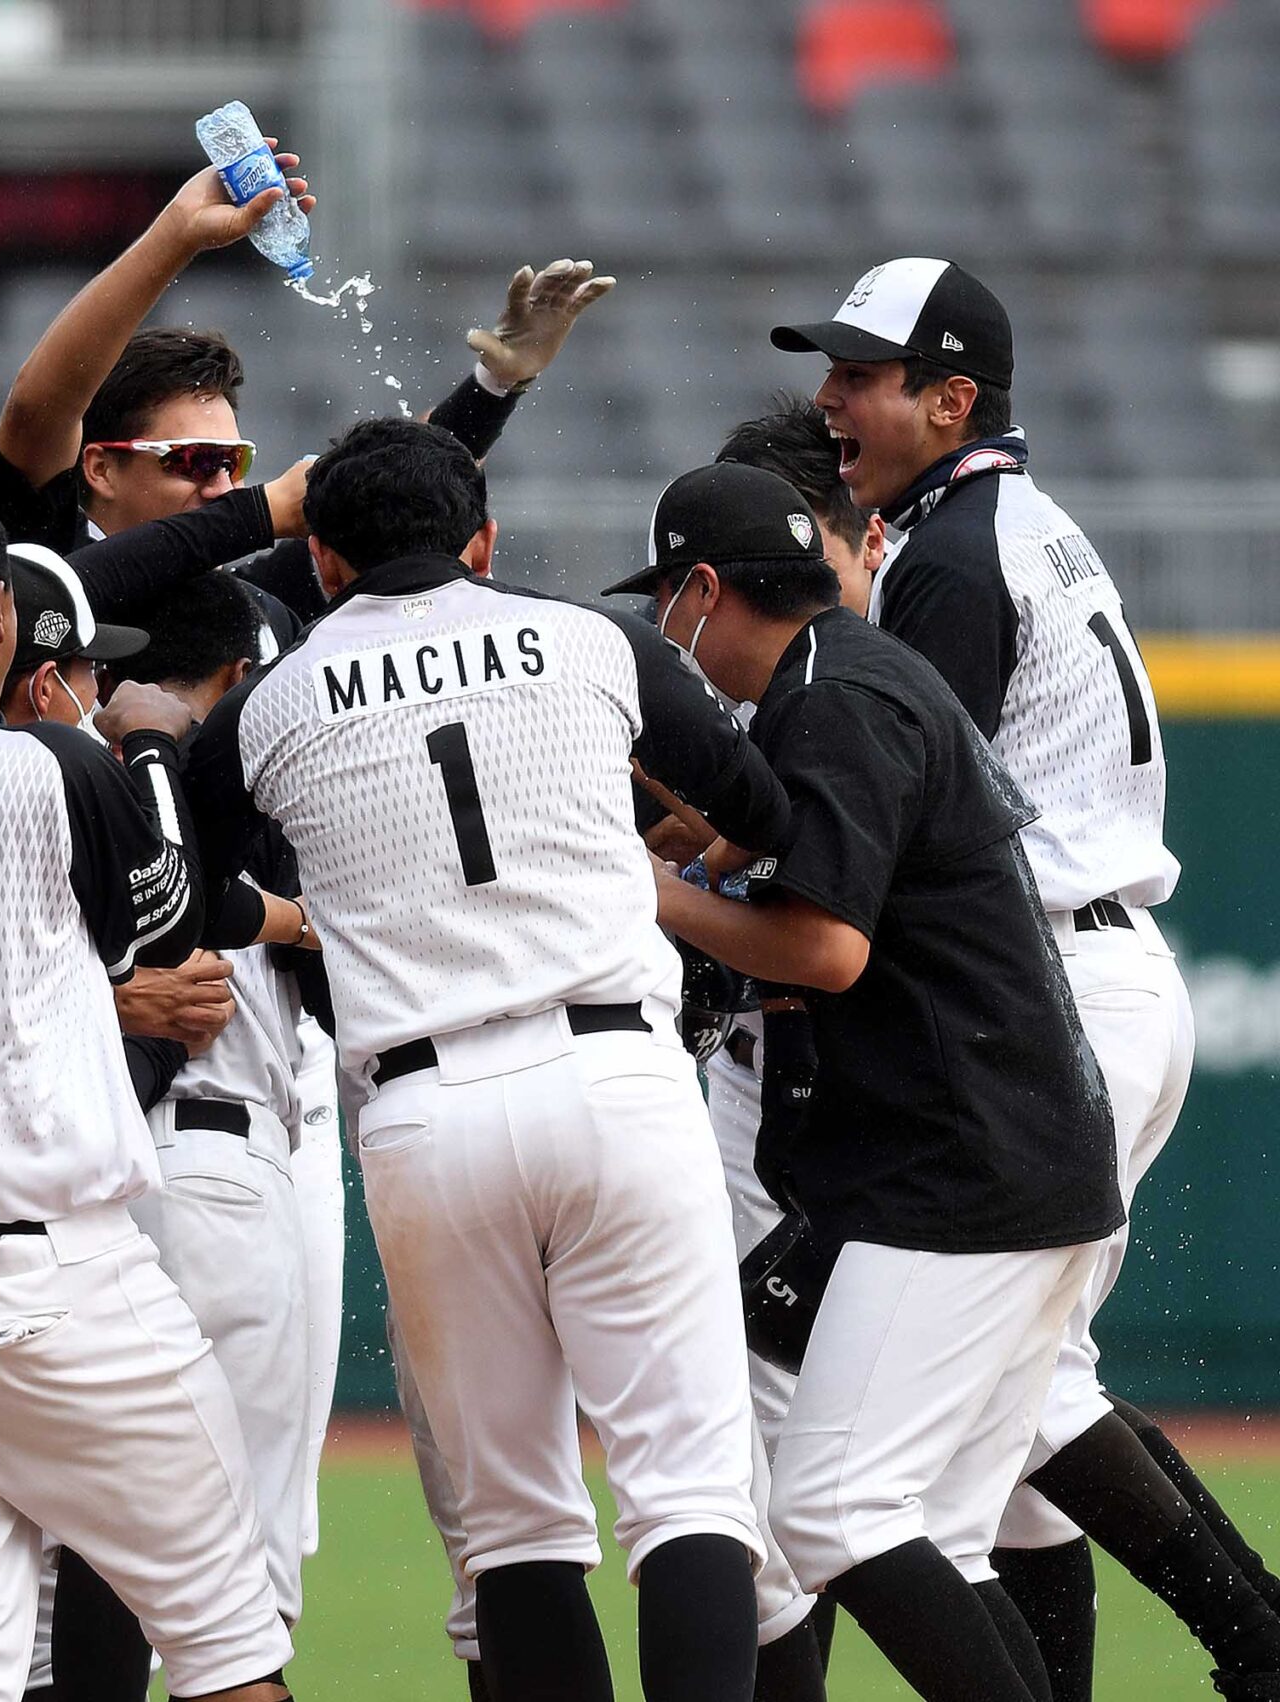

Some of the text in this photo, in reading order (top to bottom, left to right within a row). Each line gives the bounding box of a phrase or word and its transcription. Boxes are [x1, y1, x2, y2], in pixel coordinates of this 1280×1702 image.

[323, 628, 545, 714] MACIAS
[426, 721, 497, 886] 1
[766, 1276, 799, 1307] 5
